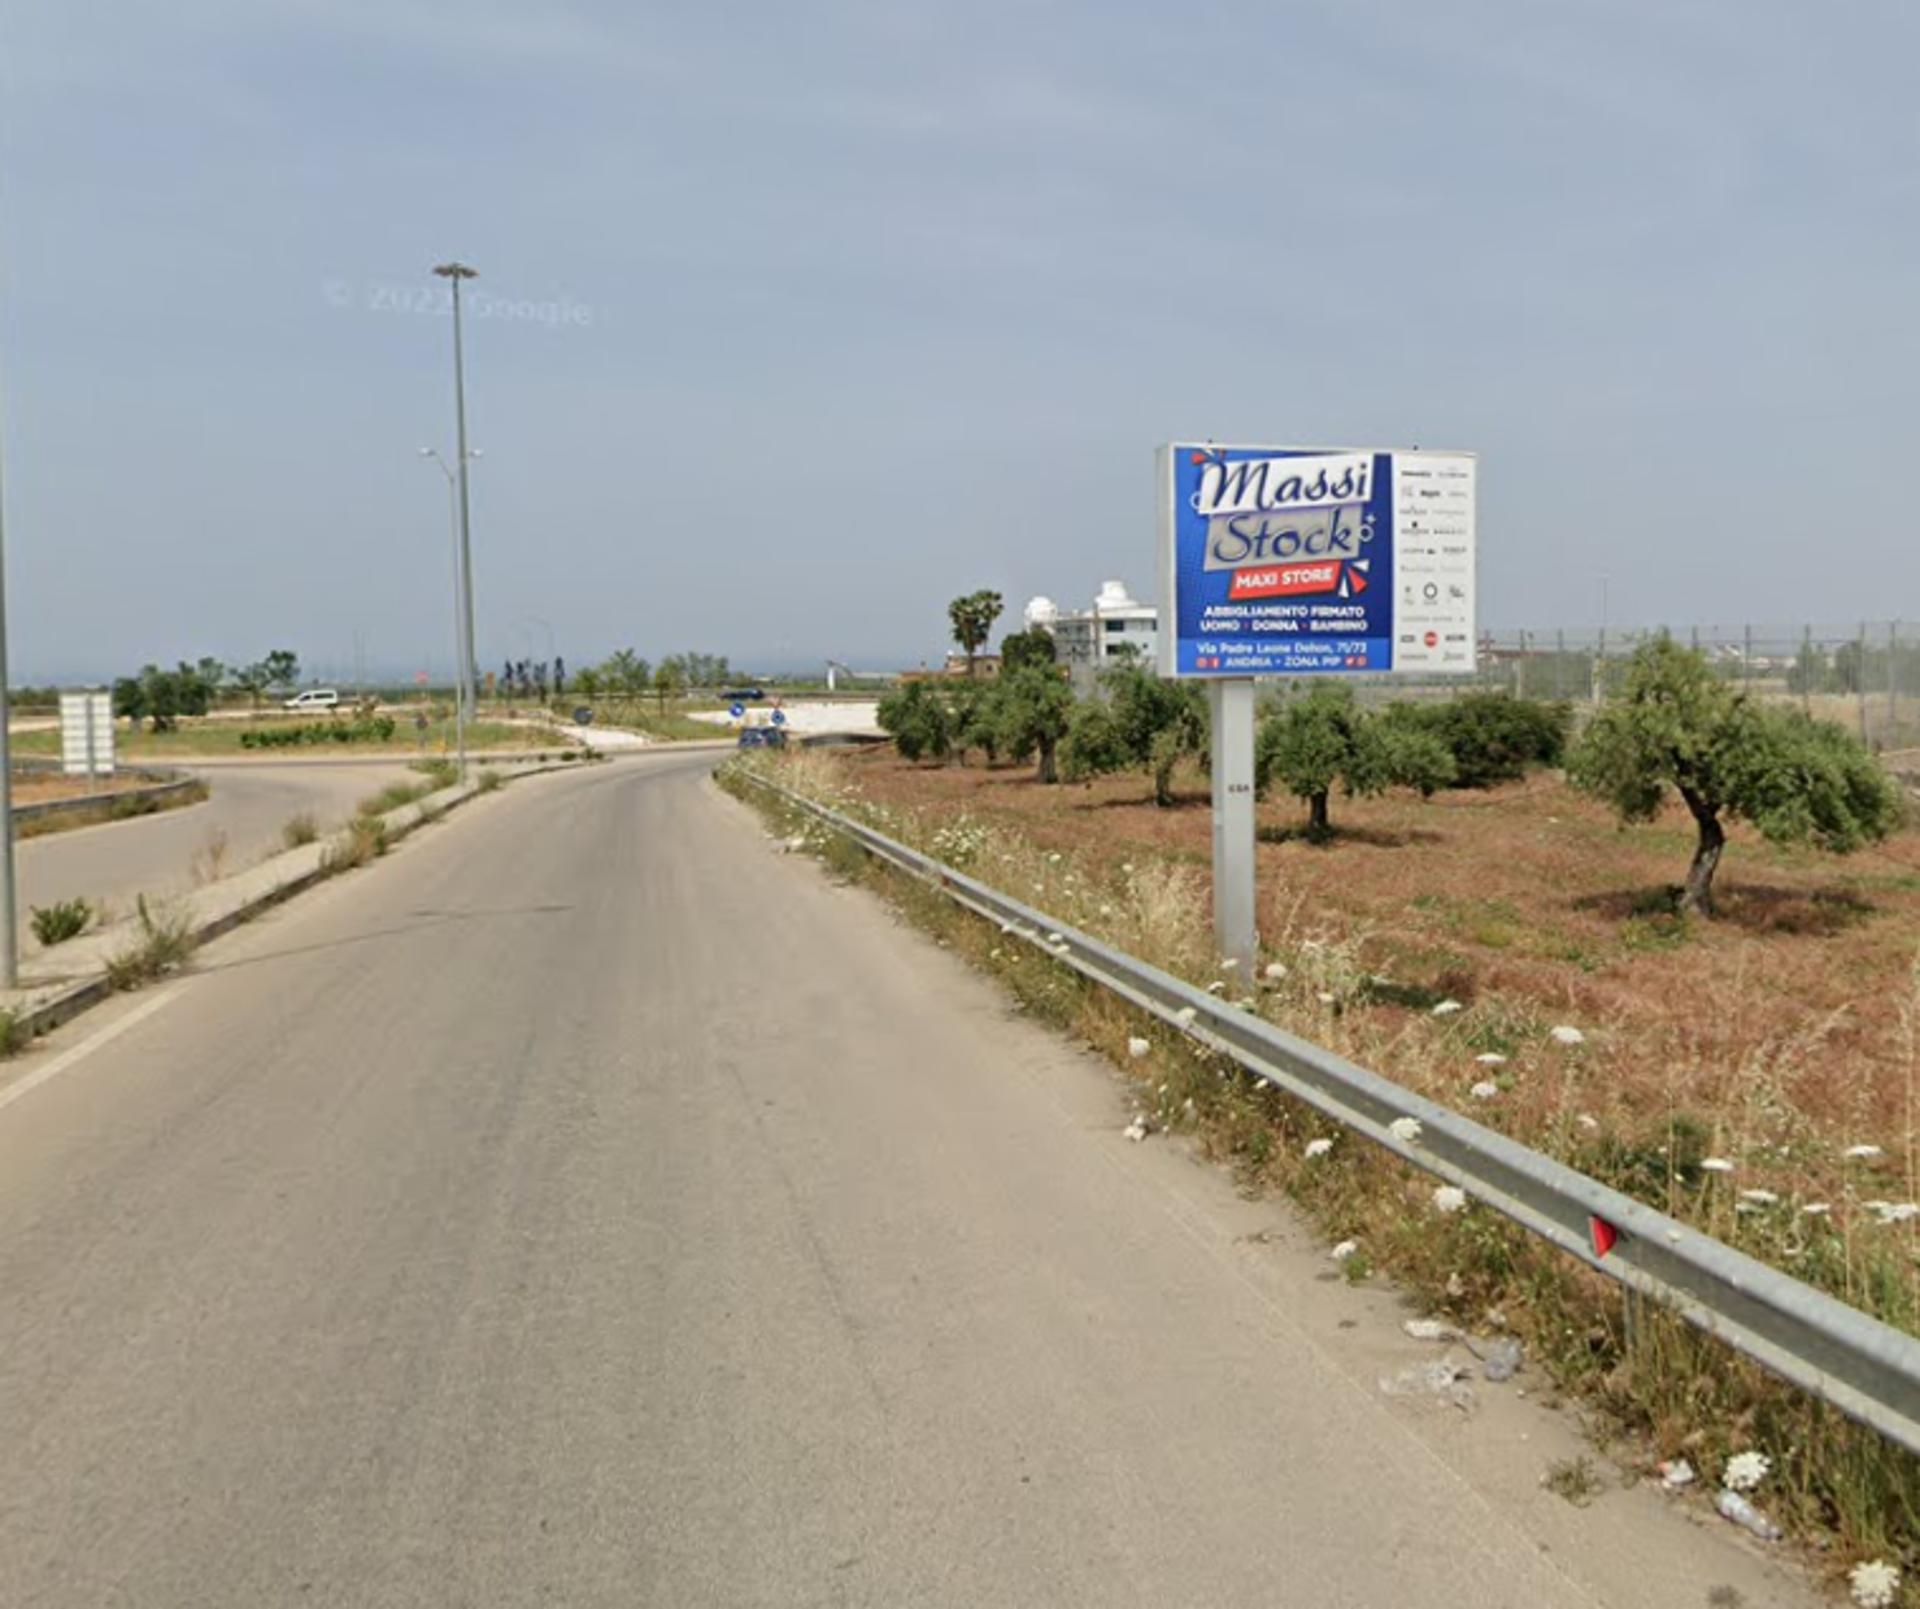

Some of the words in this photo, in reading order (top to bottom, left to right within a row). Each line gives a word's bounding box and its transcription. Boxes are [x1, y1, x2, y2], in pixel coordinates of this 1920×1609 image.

[1204, 461, 1368, 511] Massi
[1213, 507, 1352, 562] Stock
[1236, 573, 1278, 588] MAXI
[1282, 567, 1333, 585] STORE
[1205, 606, 1308, 617] ABBIGLIAMENTO
[1311, 606, 1365, 617] FIRMATO
[1201, 620, 1240, 631] UOMO
[1252, 620, 1298, 631] DONNA
[1311, 620, 1368, 631] BAMBINO
[1197, 643, 1216, 653] Via
[1225, 657, 1272, 667] ANDRIA
[1284, 656, 1319, 667] ZONA
